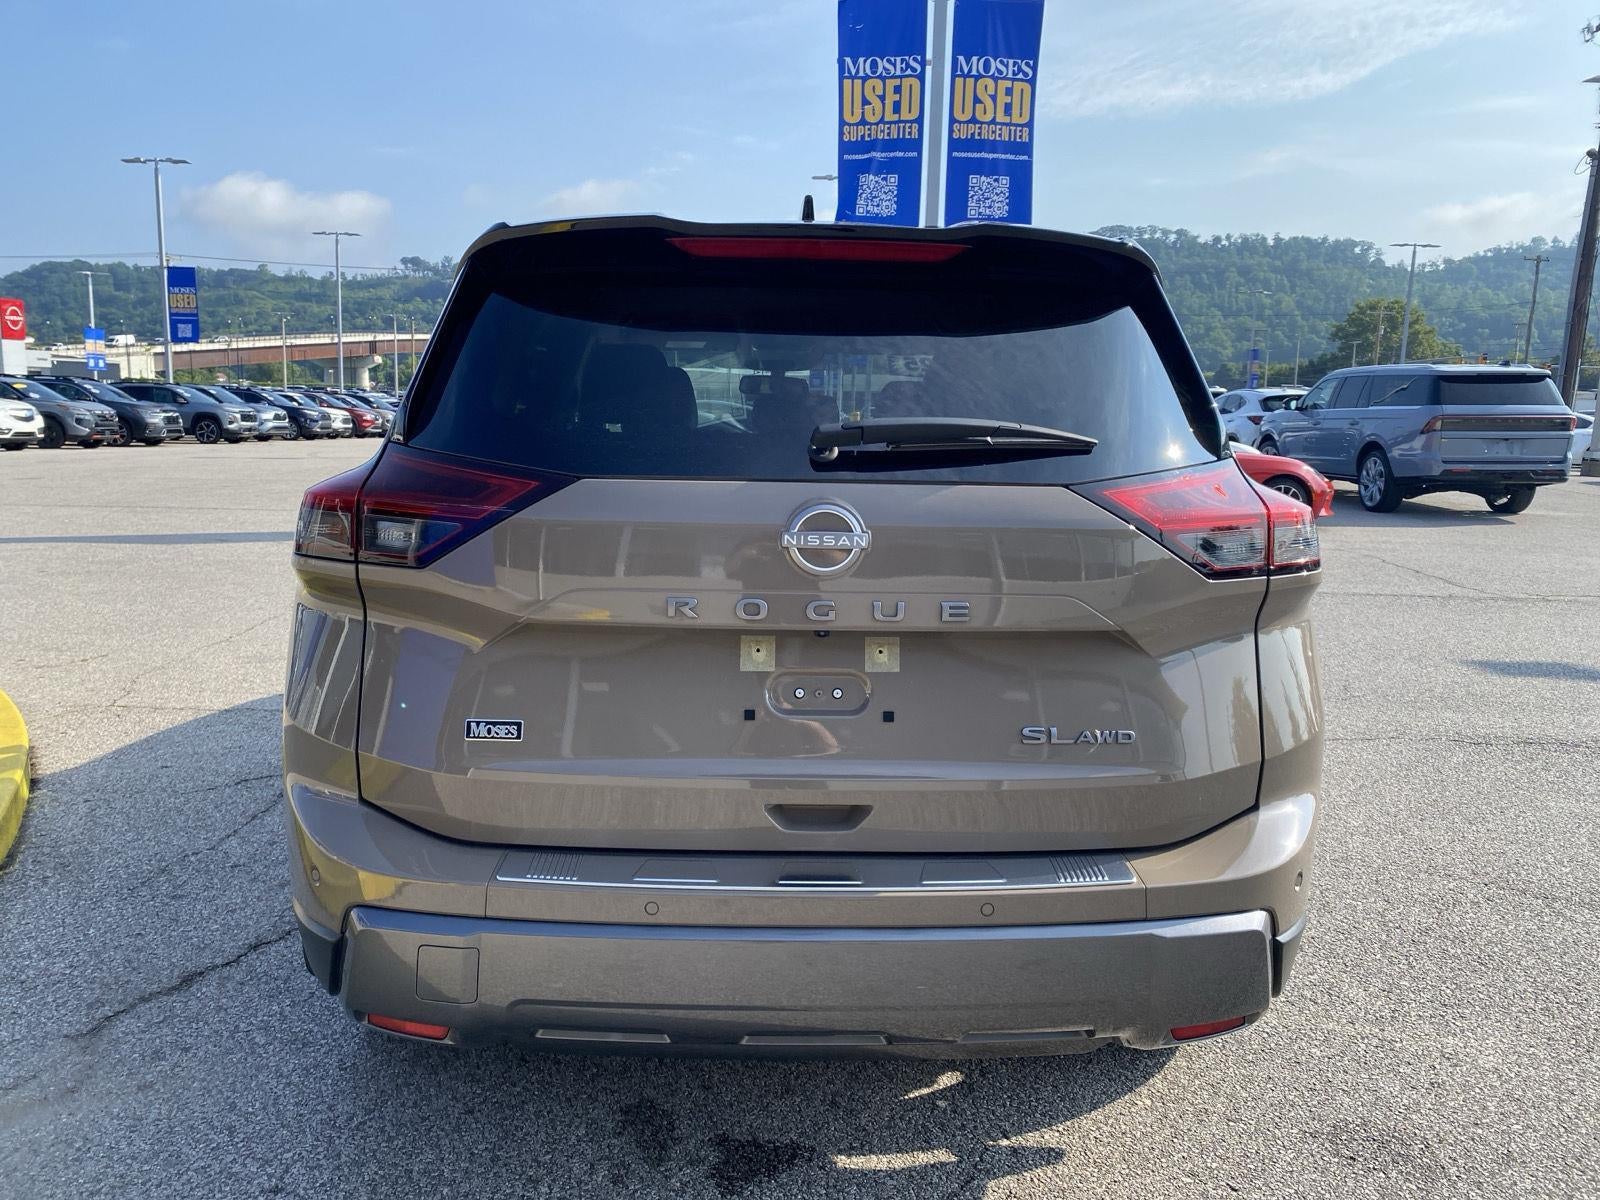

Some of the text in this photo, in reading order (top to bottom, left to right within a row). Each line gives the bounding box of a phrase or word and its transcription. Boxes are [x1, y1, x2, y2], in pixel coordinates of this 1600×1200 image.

[843, 55, 921, 77] MOSES
[956, 55, 1034, 79] MOSES
[843, 77, 921, 124] USED
[953, 77, 1032, 125] USED
[843, 123, 919, 142] SUPERCENTER
[952, 123, 1030, 142] SUPERCENTER
[784, 532, 867, 547] NISSAN
[667, 597, 970, 622] ROGUE
[469, 721, 518, 738] MOSES
